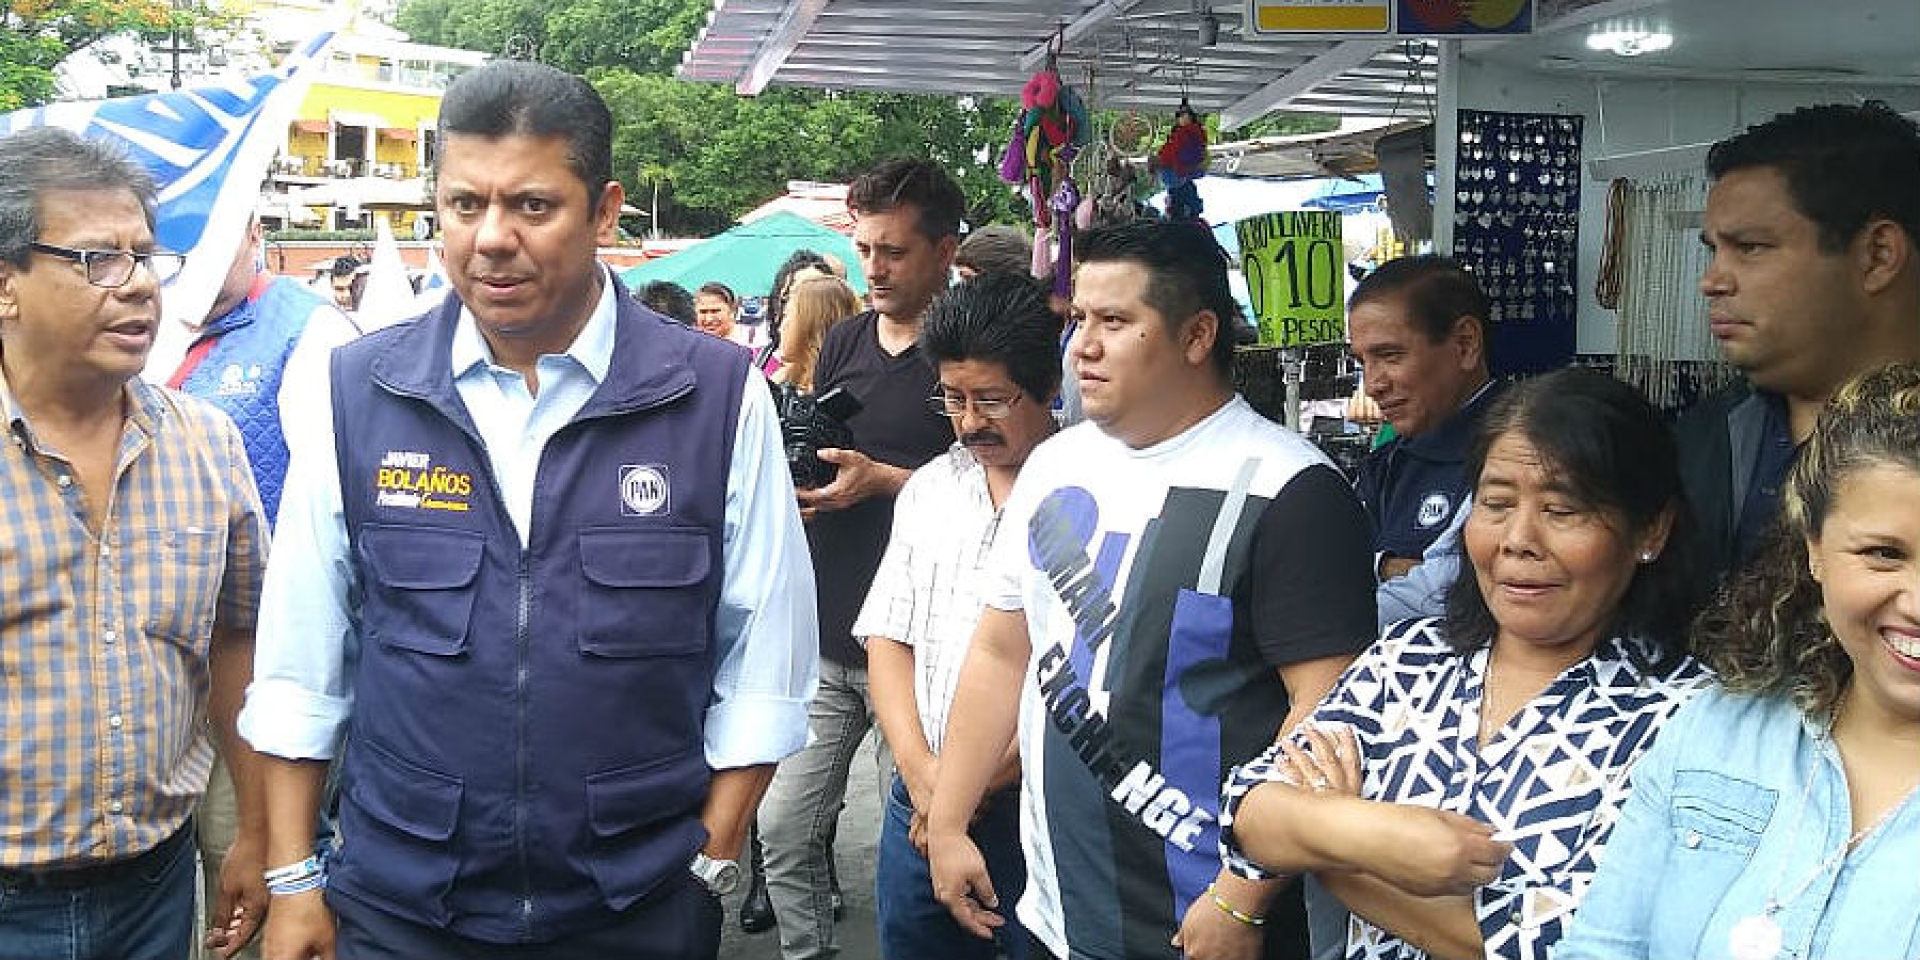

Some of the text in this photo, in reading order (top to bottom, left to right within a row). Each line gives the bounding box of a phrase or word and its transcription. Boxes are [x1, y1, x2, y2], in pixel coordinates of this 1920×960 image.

[1273, 240, 1336, 310] 10
[1281, 317, 1343, 347] PESOS
[377, 466, 471, 495] BOLAÑOS
